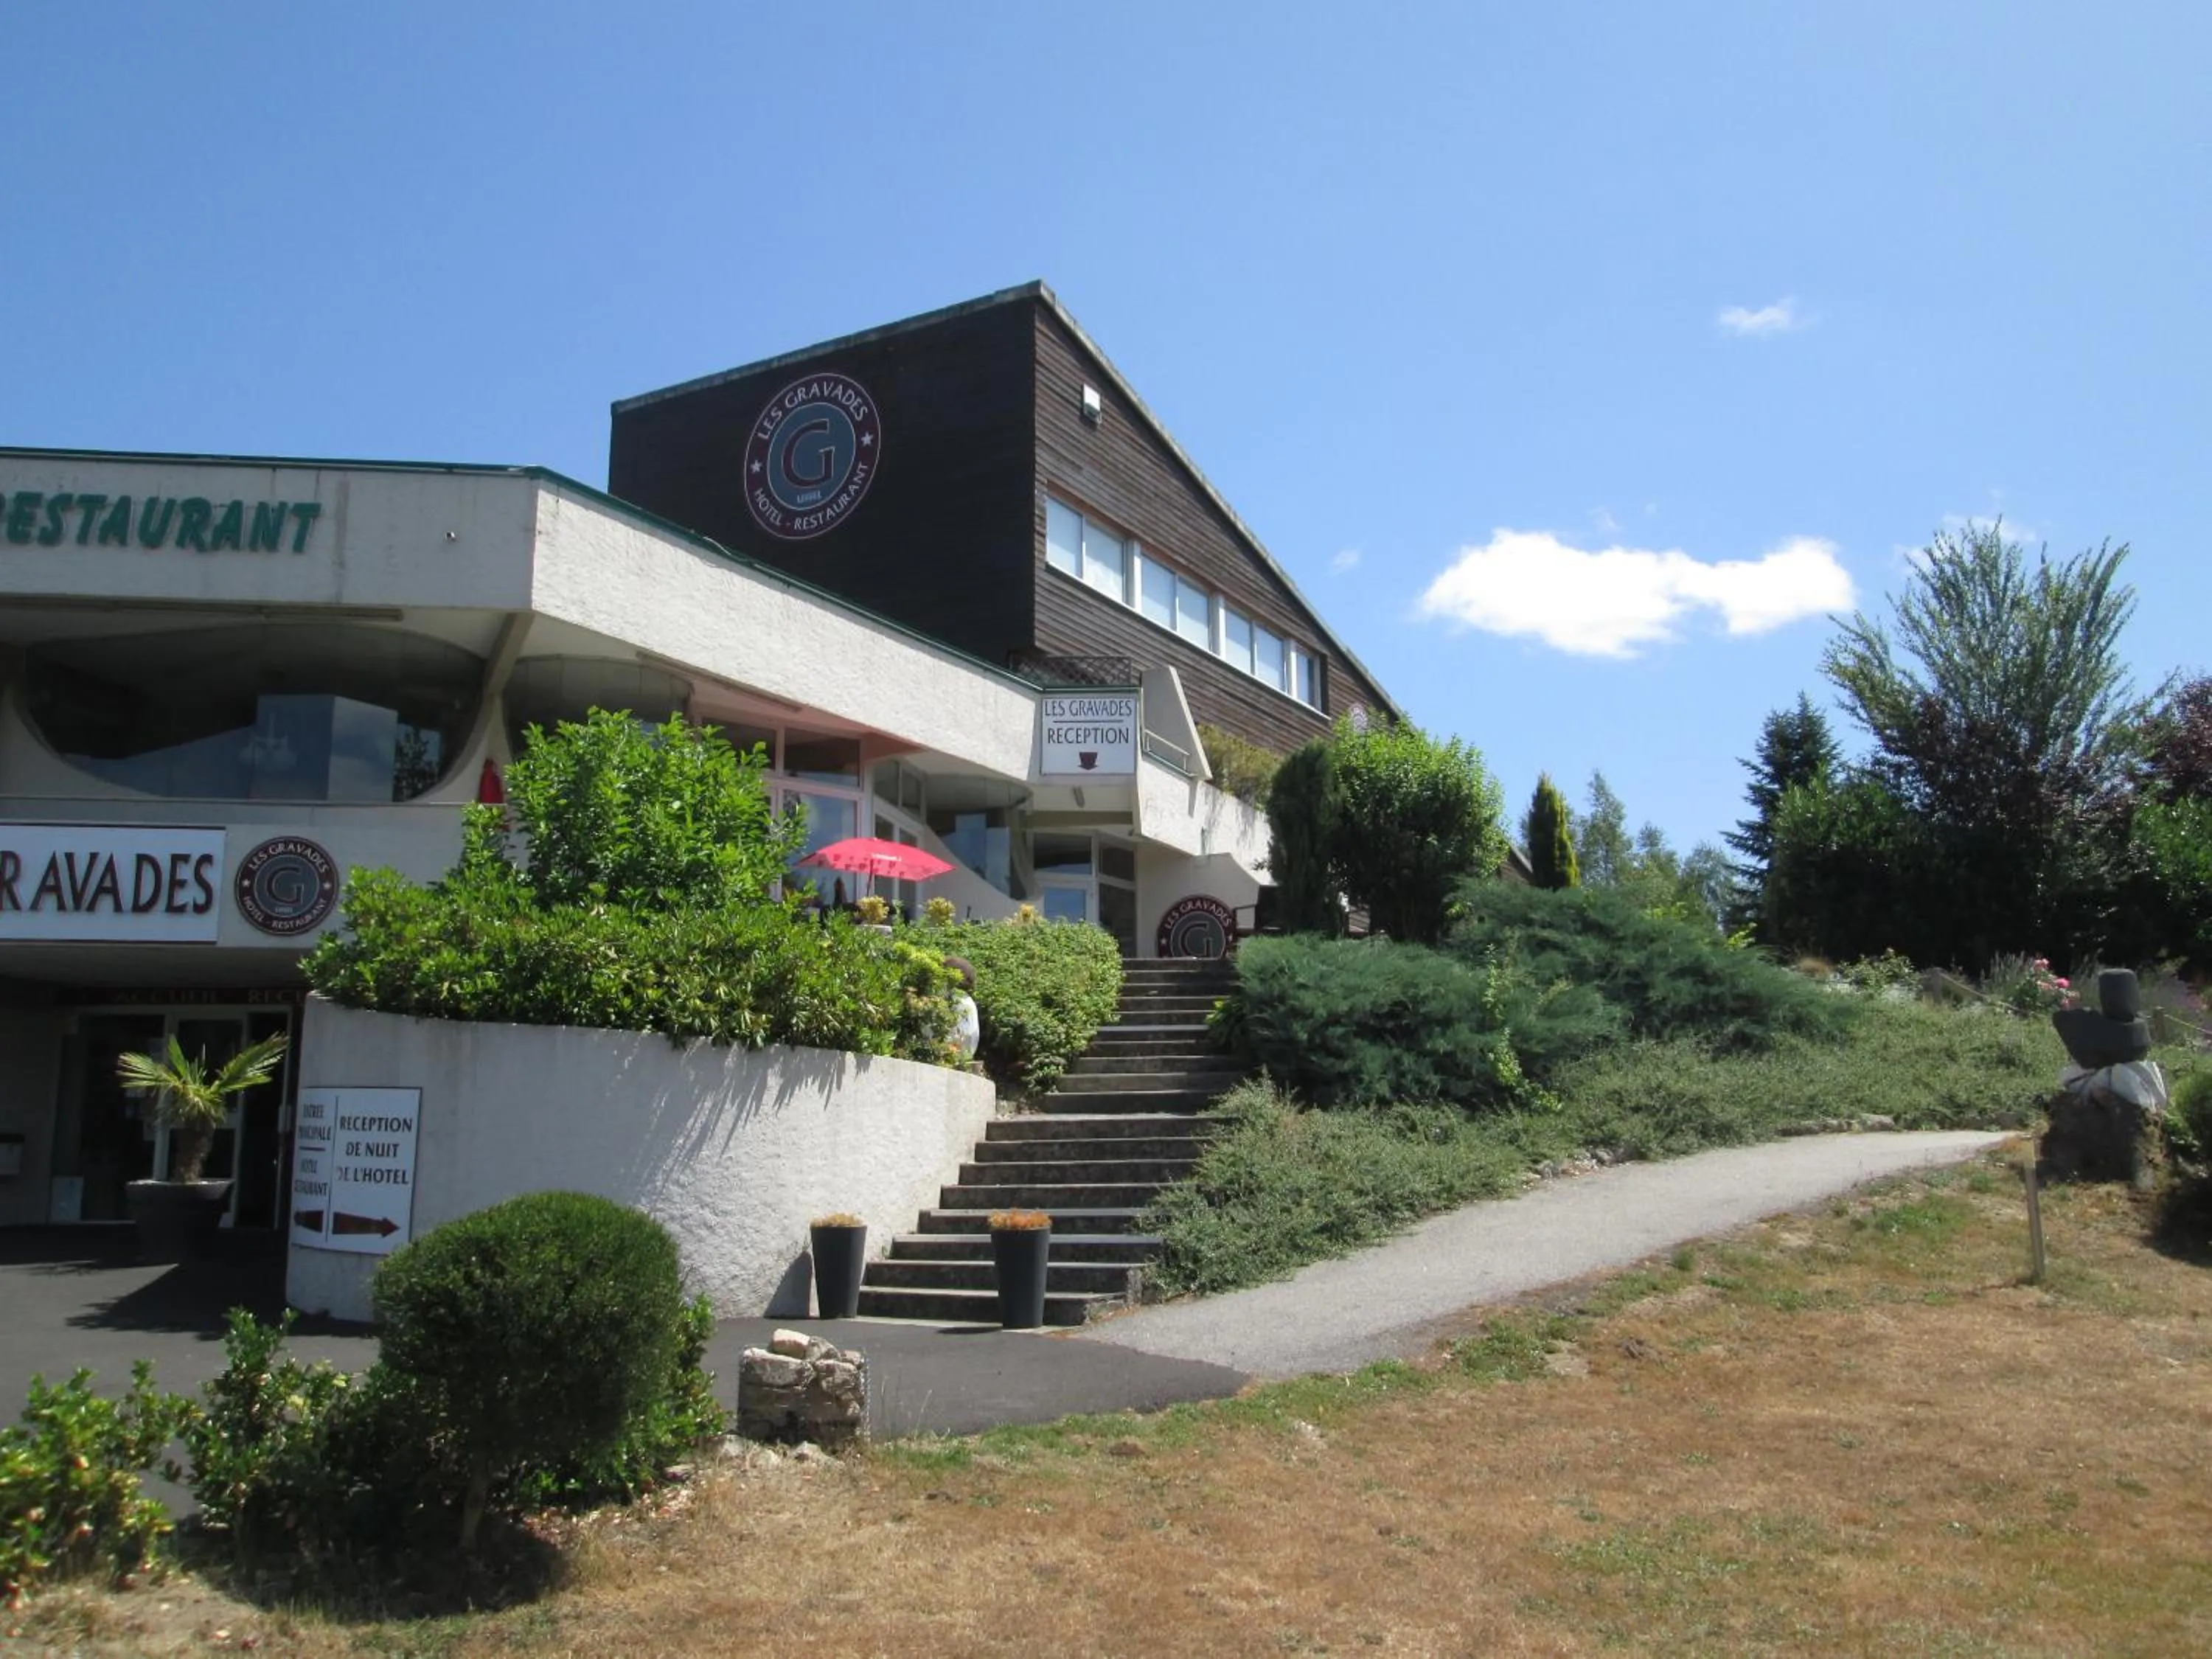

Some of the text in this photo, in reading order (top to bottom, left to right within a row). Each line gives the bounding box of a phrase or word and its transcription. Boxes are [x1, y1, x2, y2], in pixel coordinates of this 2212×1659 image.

[757, 381, 868, 440] LES GRAVADES
[782, 418, 835, 488] G
[794, 463, 868, 531] RESTAURANT
[0, 491, 321, 554] ESTAURANT
[1044, 700, 1133, 717] LES GRAVADES
[1047, 727, 1130, 745] RECEPTION
[248, 843, 330, 873] LES GRAVADES
[0, 850, 215, 914] RAVADES
[265, 864, 305, 905] G
[1165, 900, 1233, 929] LES GRAVADES
[339, 1116, 414, 1133] RECEPTION
[345, 1141, 400, 1158] DE NUIT
[337, 1166, 410, 1185] DE L'HOTEL
